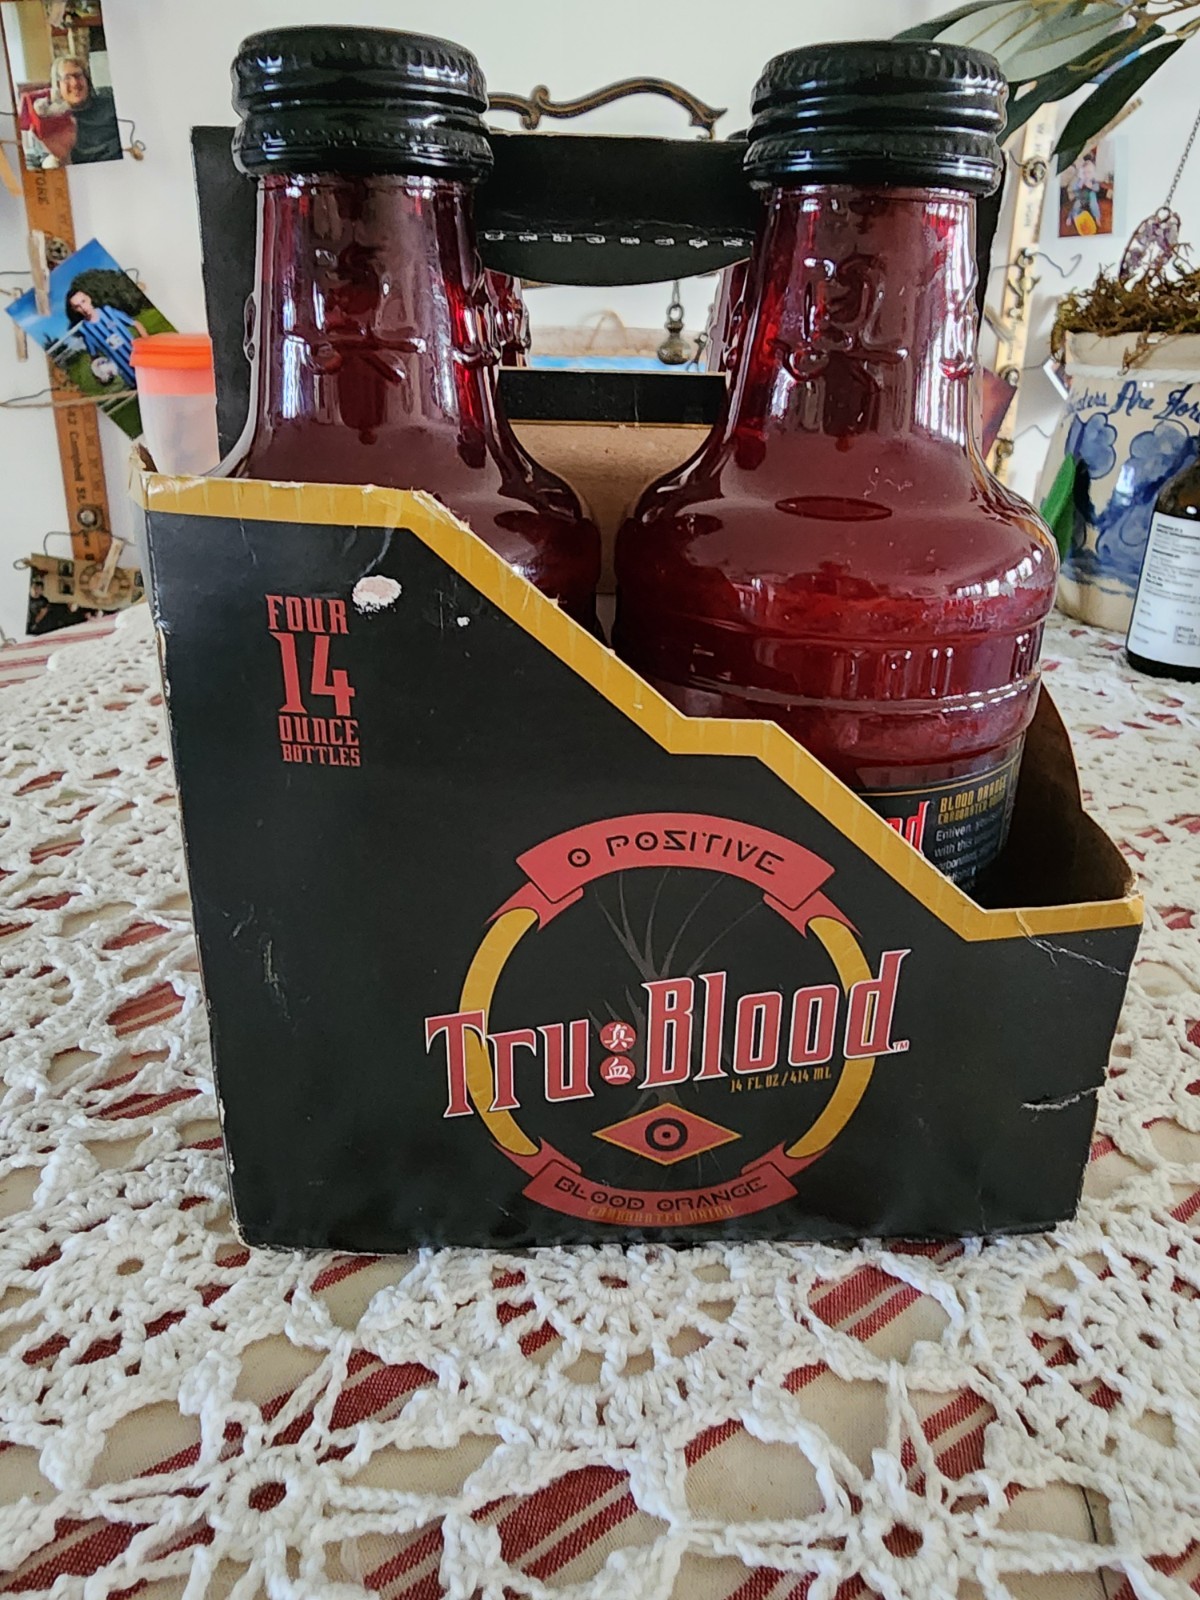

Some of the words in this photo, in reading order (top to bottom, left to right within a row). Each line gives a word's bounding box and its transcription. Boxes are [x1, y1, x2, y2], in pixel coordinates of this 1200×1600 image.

[265, 594, 350, 635] FOUR
[269, 632, 356, 717] 14
[278, 715, 360, 747] OUNCE
[281, 743, 361, 767] BOTTLES
[939, 789, 975, 814] BLOOD
[935, 823, 973, 842] Enliven
[568, 848, 591, 868] O
[606, 830, 785, 875] POSITIVE
[637, 949, 912, 1090] Blood
[424, 1009, 595, 1118] Tru
[730, 1078, 742, 1093] 14
[554, 1176, 645, 1210] BLOOD
[656, 1176, 768, 1212] ORANGE
